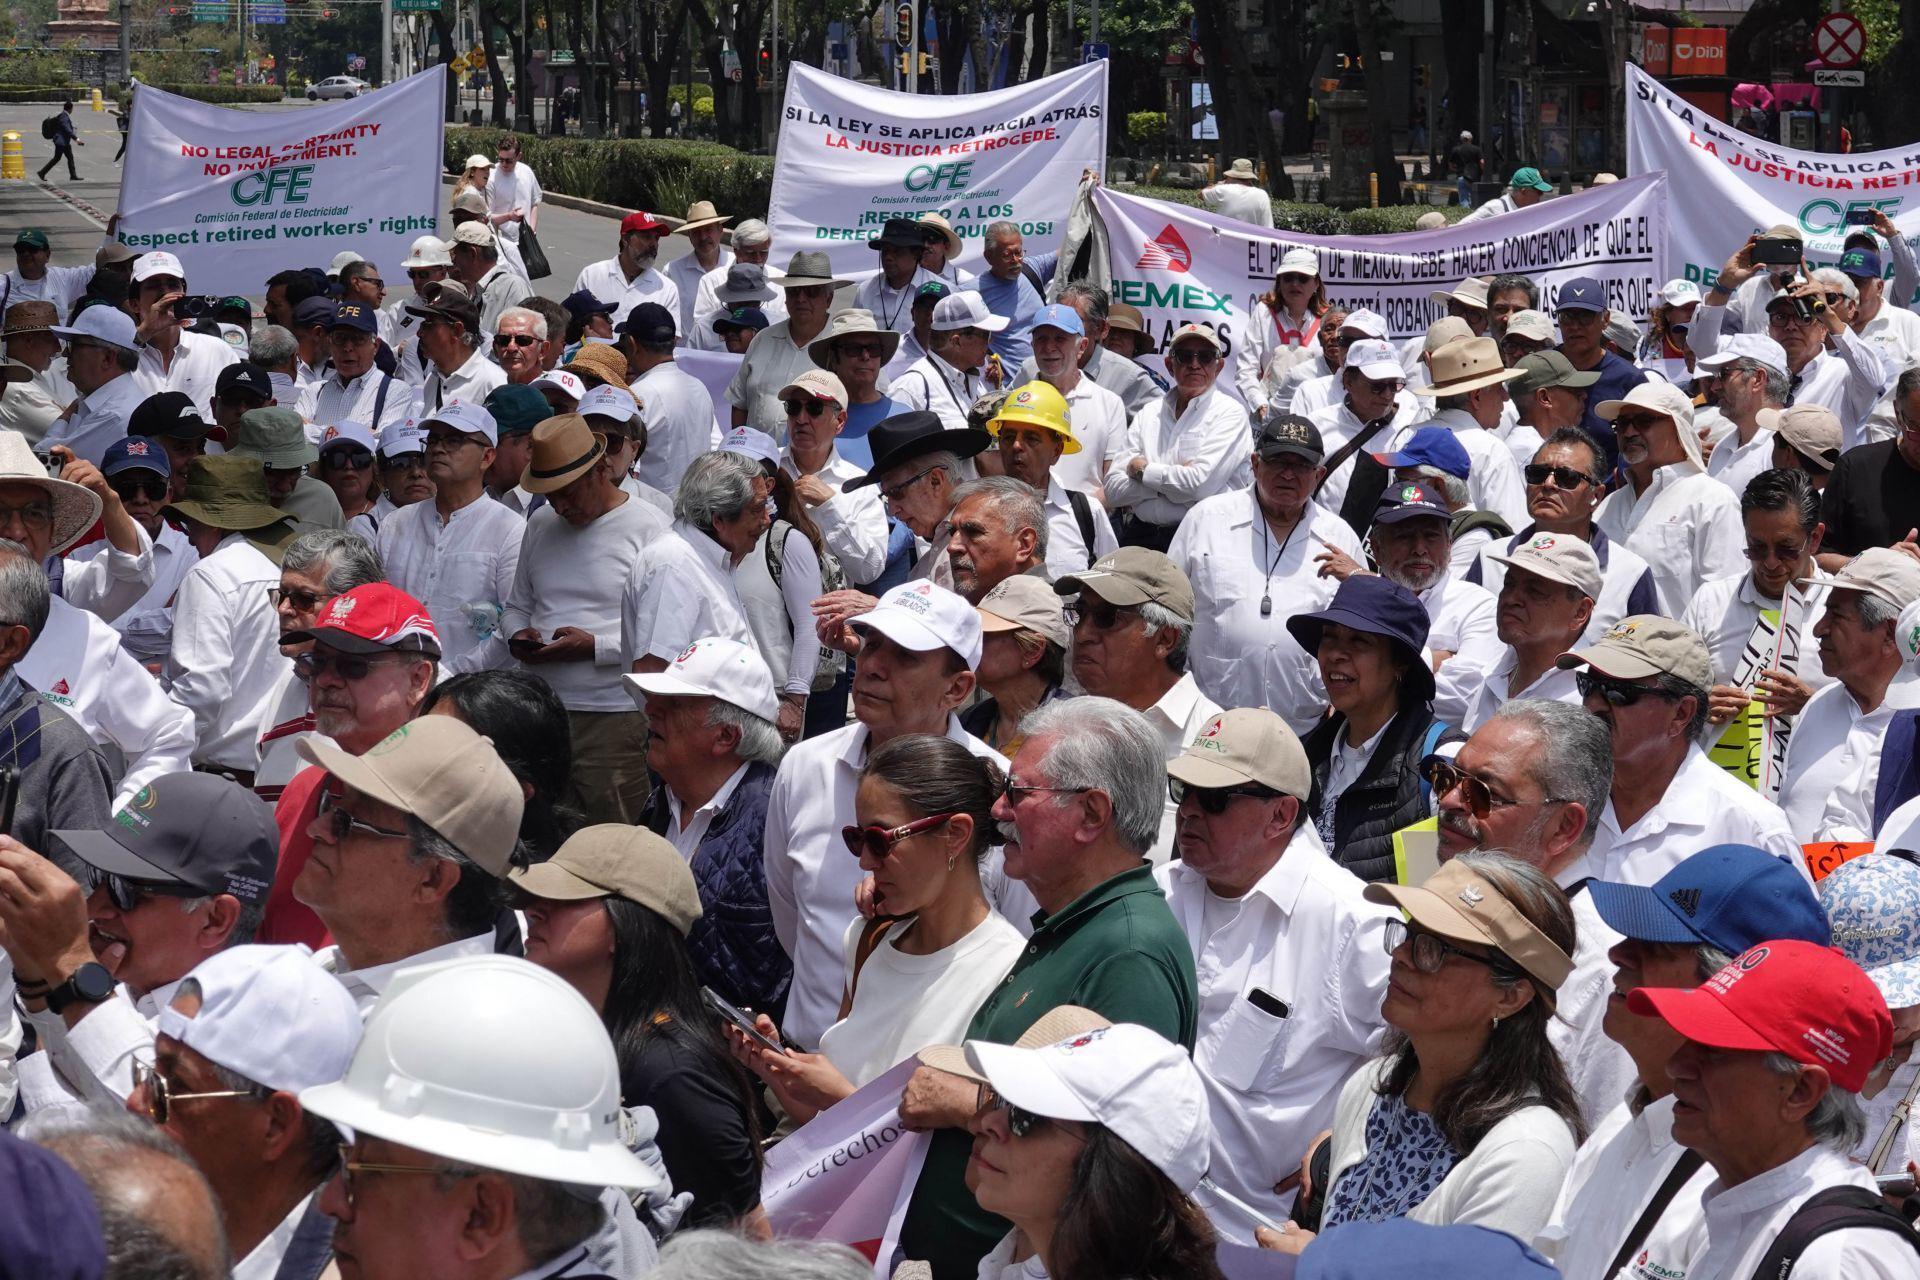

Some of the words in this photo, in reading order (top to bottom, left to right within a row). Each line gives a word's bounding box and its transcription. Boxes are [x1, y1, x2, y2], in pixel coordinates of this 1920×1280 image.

[1696, 46, 1723, 59] DiDi
[786, 106, 802, 121] SI
[808, 111, 832, 127] LA
[838, 117, 873, 134] LEY
[879, 125, 902, 138] SE
[908, 126, 976, 139] APLICA
[981, 115, 1036, 136] HACIA
[1636, 80, 1657, 103] SI
[1666, 98, 1694, 126] LA
[1755, 149, 1786, 165] SE
[1796, 161, 1895, 174] APLICA
[181, 144, 209, 158] NO
[215, 146, 272, 159] LEGAL
[825, 133, 849, 150] LA
[855, 139, 941, 157] JUSTICIA
[948, 128, 1060, 155] RETROCEDE.
[203, 163, 231, 176] NO
[1689, 131, 1718, 158] LA
[1727, 152, 1854, 190] JUSTICIA
[230, 163, 316, 207] CFE
[902, 160, 976, 193] CFE
[871, 195, 908, 204] Comisión
[911, 194, 941, 204] Federal
[195, 212, 239, 224] Comisión
[242, 210, 278, 222] Federal
[280, 208, 292, 219] de
[294, 205, 349, 218] Electricidad
[859, 209, 952, 226] ¡RESPEO
[958, 207, 971, 220] A
[977, 204, 1013, 219] LOS
[118, 226, 199, 249] Respect
[206, 222, 277, 243] retired
[283, 218, 373, 238] workers'
[379, 214, 437, 235] rights
[816, 226, 885, 241] DEREC
[1249, 241, 1263, 272] EL
[1328, 247, 1345, 278] DE
[1411, 250, 1445, 279] DEBE
[1453, 241, 1496, 275] HACER
[1503, 224, 1578, 268] CONCIENCIA
[1584, 222, 1600, 256] DE
[1607, 216, 1632, 255] QUE
[1638, 216, 1653, 254] EL
[1628, 278, 1652, 317] QUE
[336, 305, 361, 318] CFE
[561, 375, 574, 388] CO
[893, 597, 927, 616] JUBILADOS
[901, 591, 933, 609] PEMEX
[1192, 738, 1223, 753] EMEX
